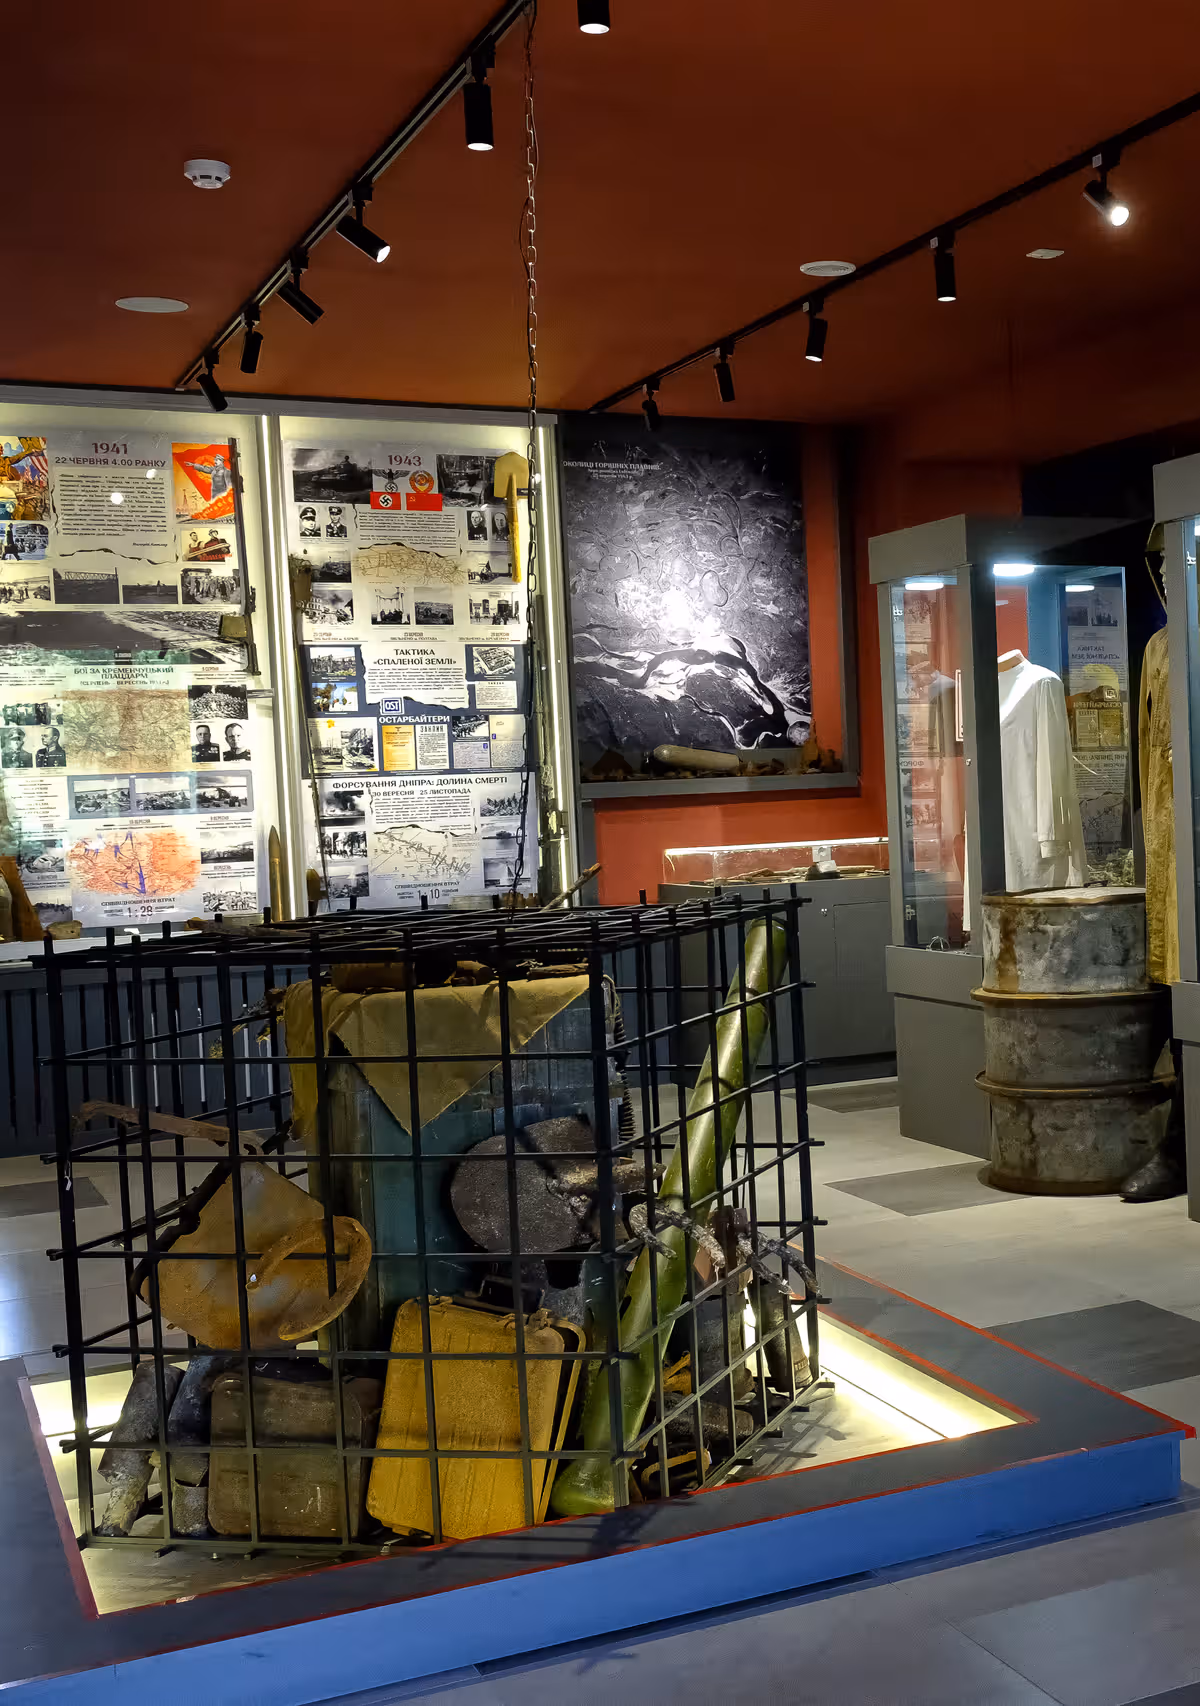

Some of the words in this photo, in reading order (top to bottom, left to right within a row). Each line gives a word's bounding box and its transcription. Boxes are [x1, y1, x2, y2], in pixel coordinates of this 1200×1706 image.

[91, 442, 129, 455] 1941
[55, 456, 67, 464] 22
[69, 457, 109, 466] ЧЕРВНЯ
[111, 458, 133, 467] 4.00
[135, 459, 166, 468] РАНКУ
[387, 454, 422, 467] 1943
[393, 648, 436, 656] ТАКТИКА
[373, 656, 424, 666] «СПАЛЕНОЇ
[74, 667, 88, 675] БОЇ
[102, 665, 174, 674] КРЕМЕНЧУЦЬКИЙ
[385, 701, 399, 711] OST
[378, 714, 450, 724] ОСТАРБАЙТЕРИ
[332, 781, 397, 790] ФОРСУВАННЯ
[398, 780, 435, 788] ДНІПРА:
[436, 778, 473, 787] ДОЛИНА
[474, 776, 508, 785] СМЕРТІ
[429, 788, 471, 796] ЛИСТОПАДА
[430, 888, 440, 899] 10
[140, 905, 153, 917] 28
